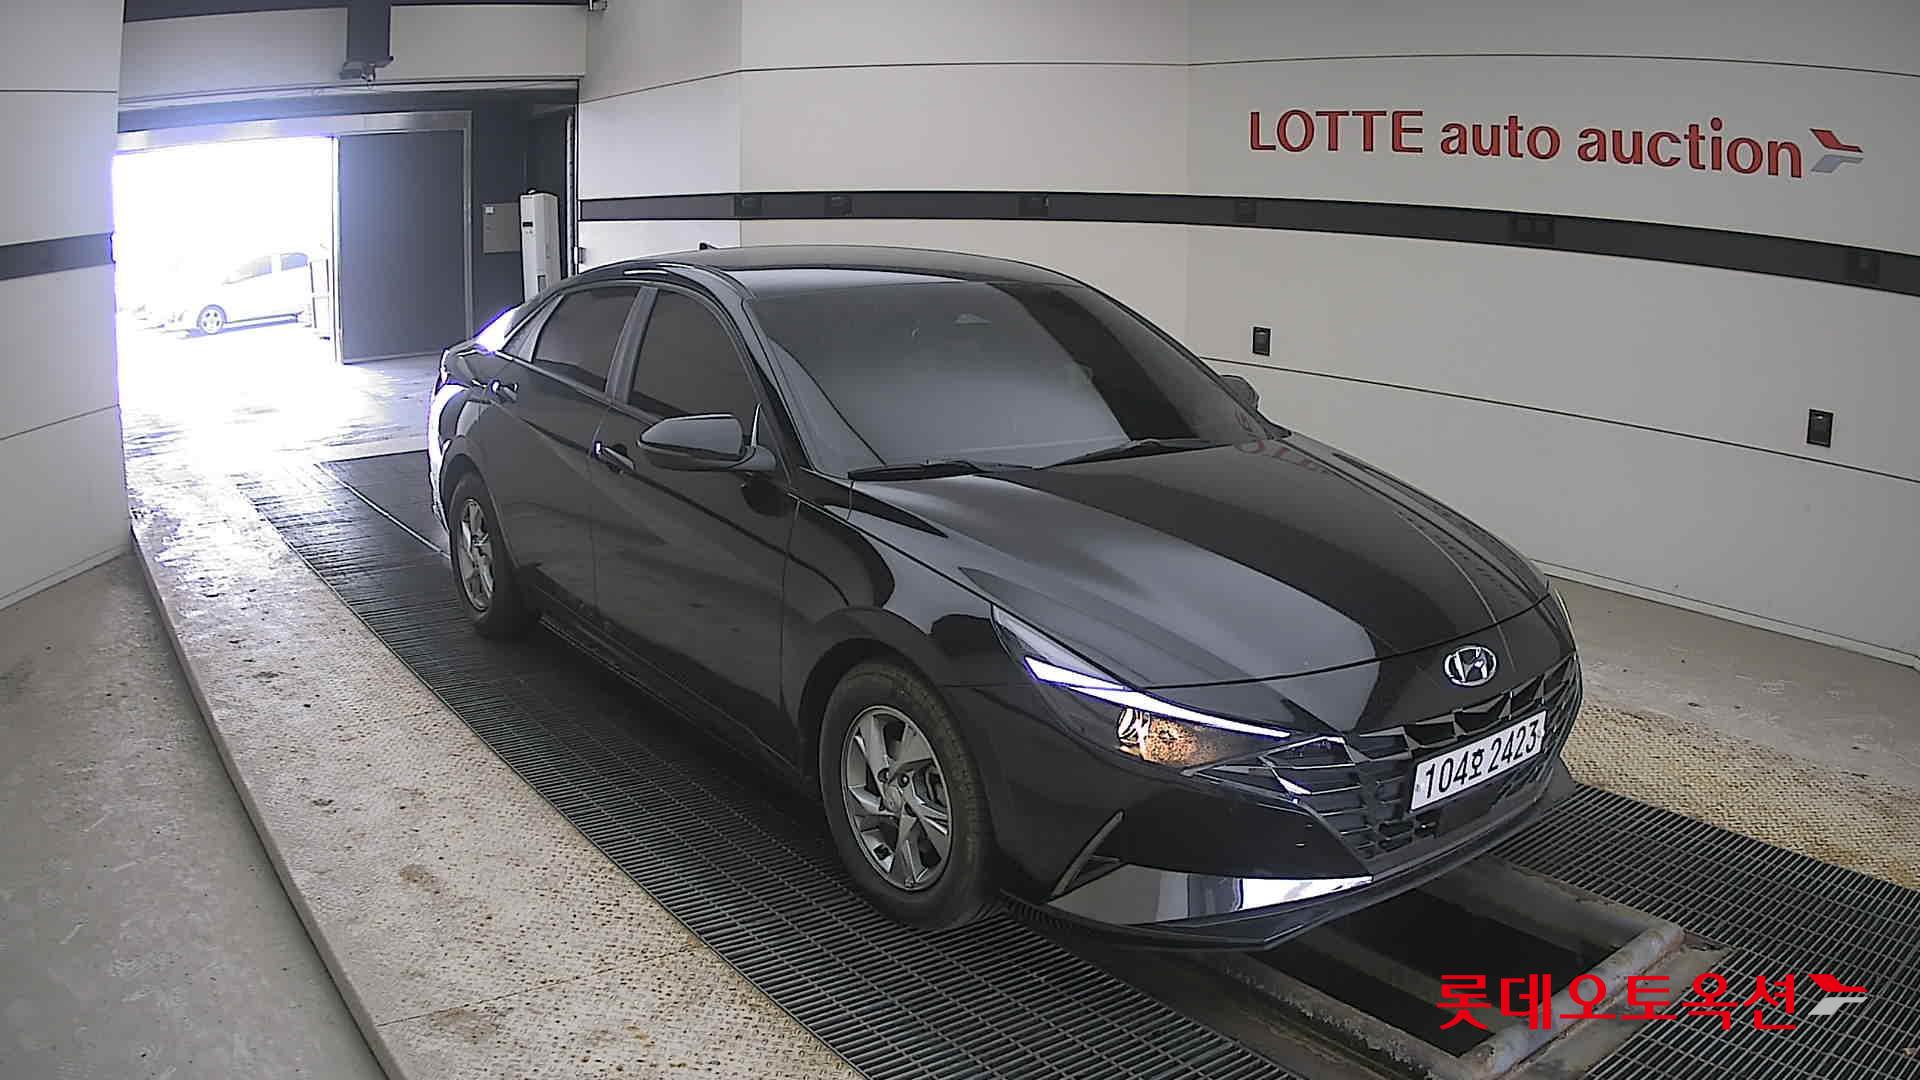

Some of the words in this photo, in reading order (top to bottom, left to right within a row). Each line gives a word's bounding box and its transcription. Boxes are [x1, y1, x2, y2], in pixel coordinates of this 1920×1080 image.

[1249, 110, 1424, 153] LOTTE
[1440, 115, 1561, 160] auto
[1577, 117, 1803, 178] auction
[1488, 720, 1539, 772] 2423
